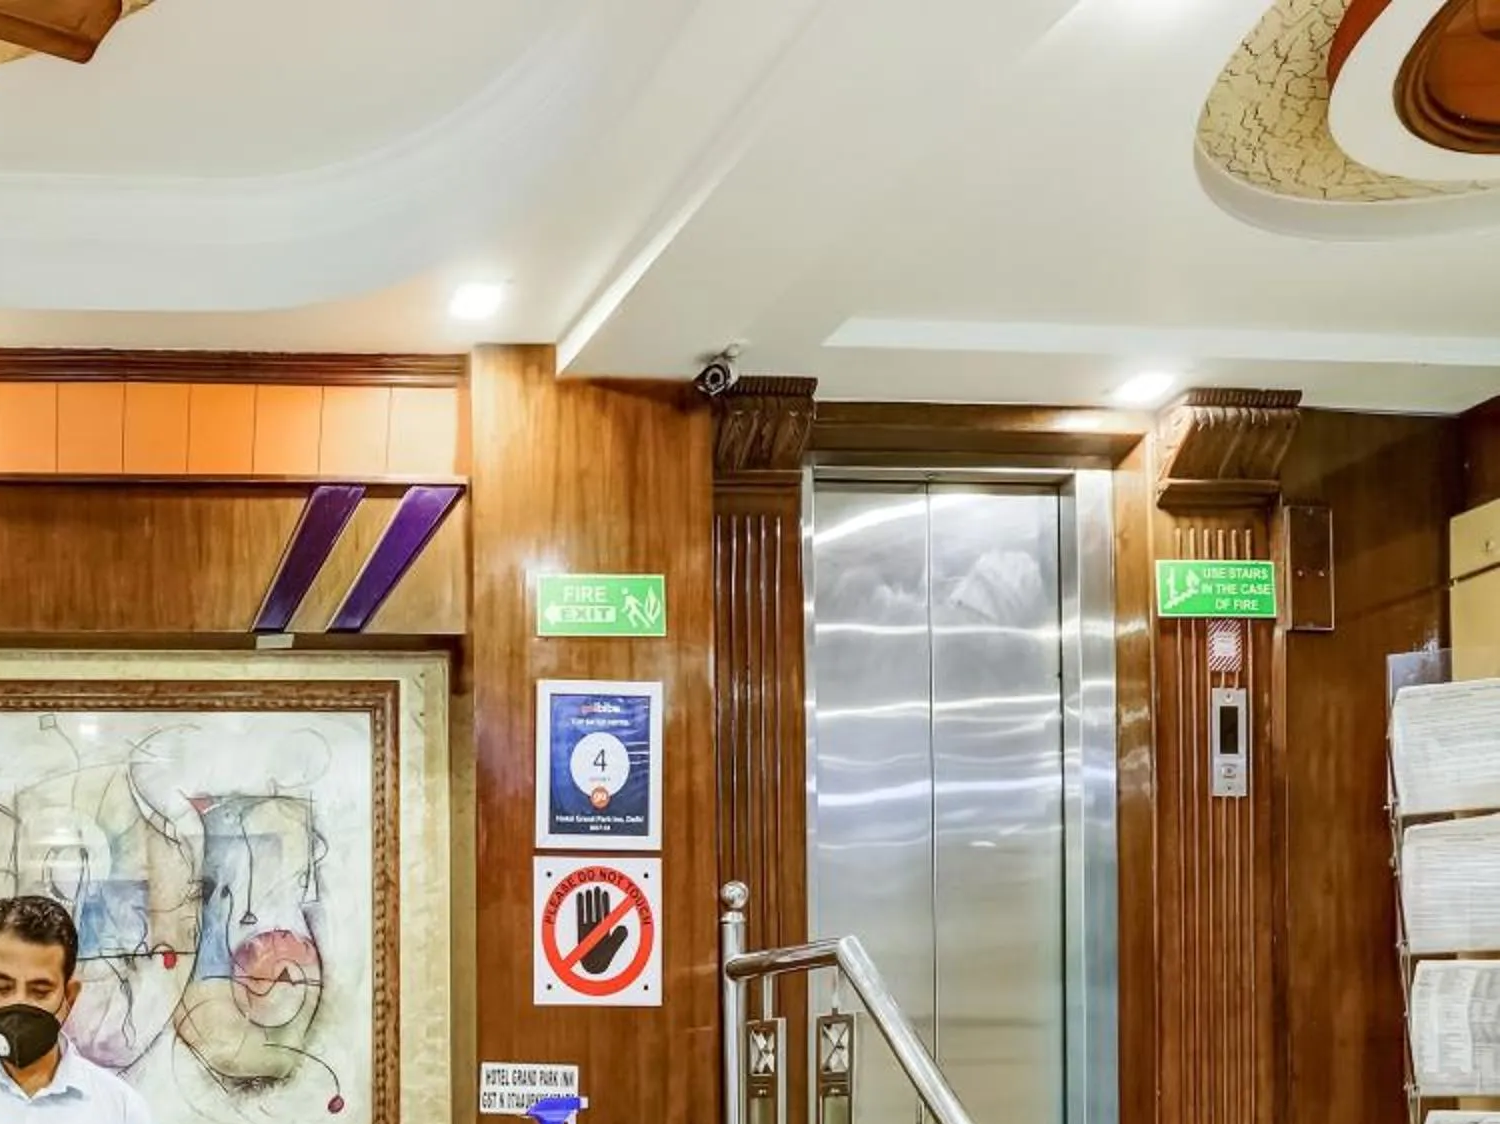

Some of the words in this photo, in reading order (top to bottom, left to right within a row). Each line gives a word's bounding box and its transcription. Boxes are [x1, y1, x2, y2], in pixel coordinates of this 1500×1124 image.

[1204, 567, 1226, 579] USE
[1229, 567, 1268, 580] STAIRS
[562, 585, 608, 603] FIRE
[1201, 584, 1213, 594] IN
[1216, 584, 1237, 594] THE
[1240, 584, 1271, 595] CASE
[1215, 598, 1231, 610] OF
[1233, 599, 1259, 611] FIRE
[560, 607, 611, 621] EXIT
[593, 748, 608, 772] 4
[543, 880, 578, 925] PLEASE
[579, 869, 595, 884] DO
[599, 870, 624, 886] NOT
[627, 881, 652, 925] TOUCH
[485, 1069, 510, 1086] HOTEL
[512, 1069, 537, 1086] GRAND
[540, 1070, 559, 1087] PARK
[482, 1091, 497, 1109] GST
